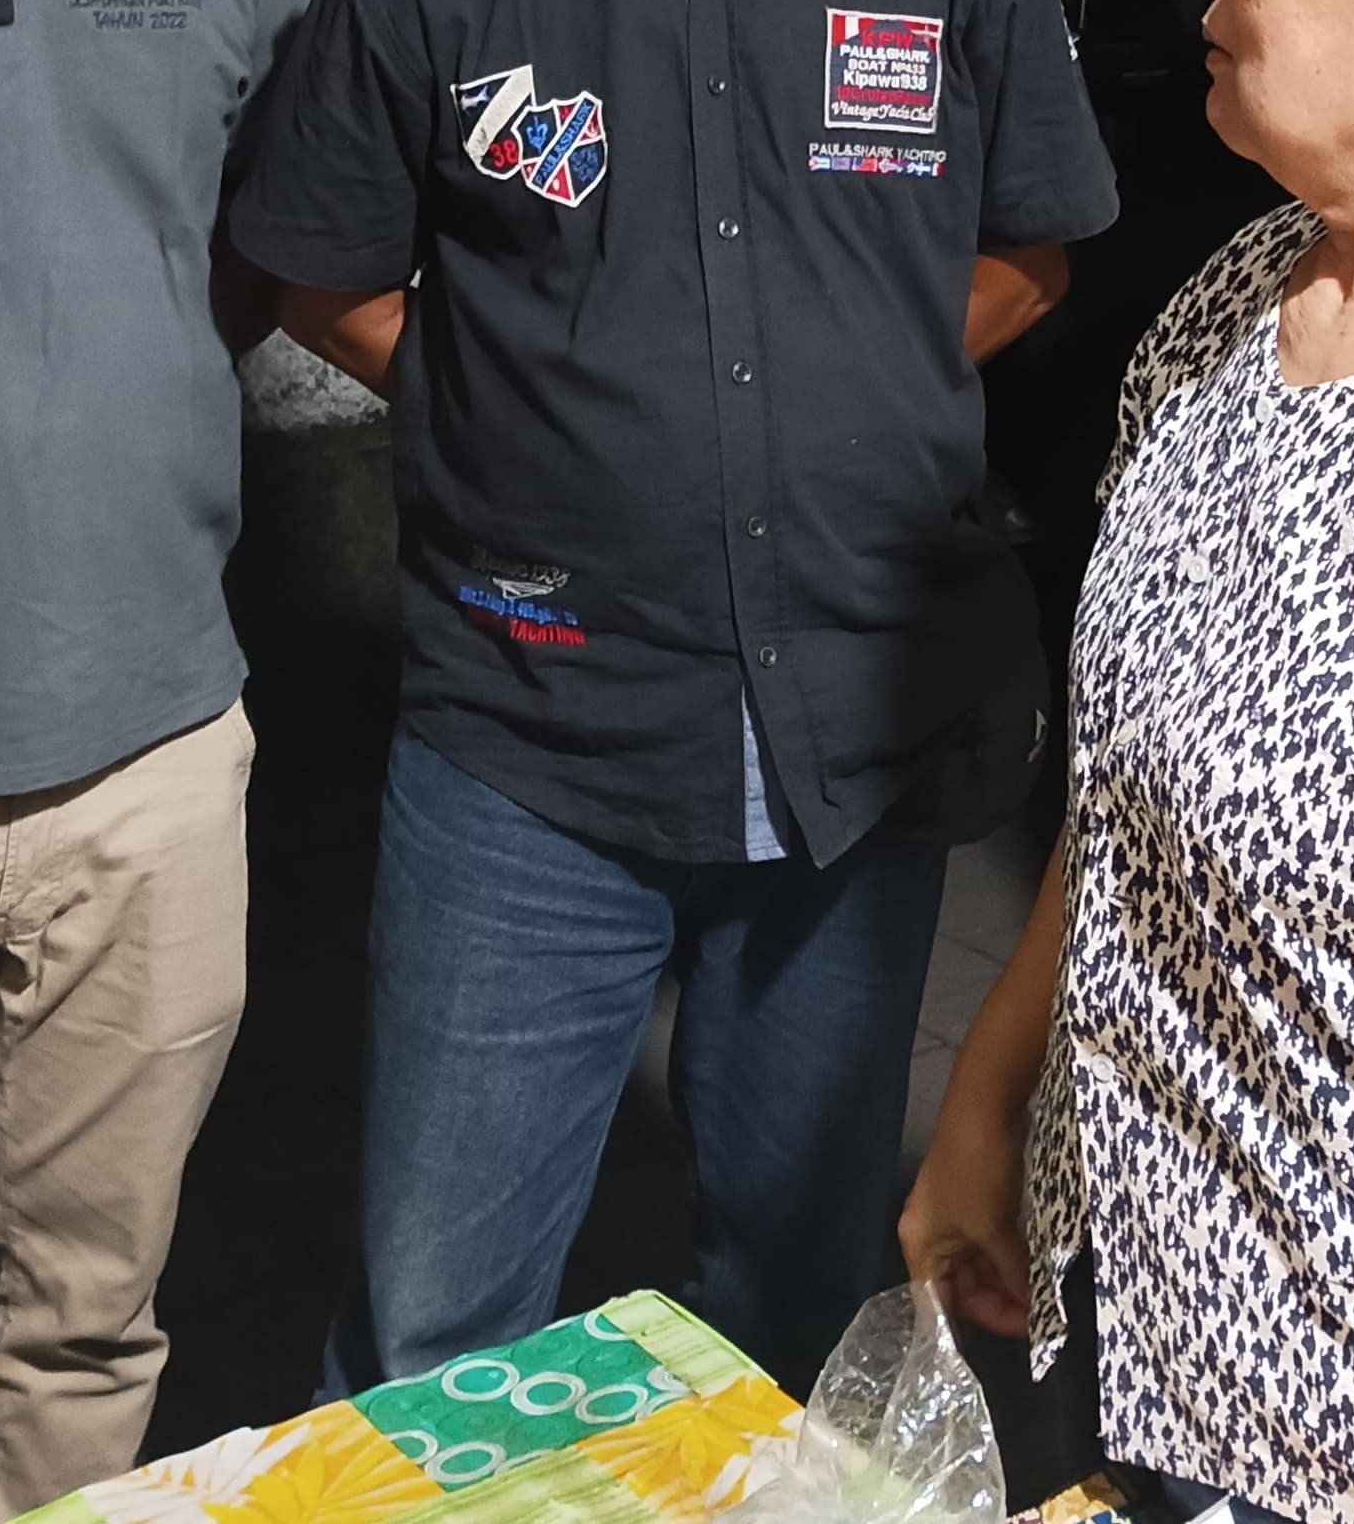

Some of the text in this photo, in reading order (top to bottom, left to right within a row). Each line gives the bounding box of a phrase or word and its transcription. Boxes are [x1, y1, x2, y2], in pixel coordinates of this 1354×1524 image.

[92, 10, 145, 29] TAHUN
[839, 44, 932, 64] PAUL&SHARK
[847, 58, 888, 73] BOAT
[488, 139, 519, 169] 38
[808, 142, 895, 159] PAUL&SHARK
